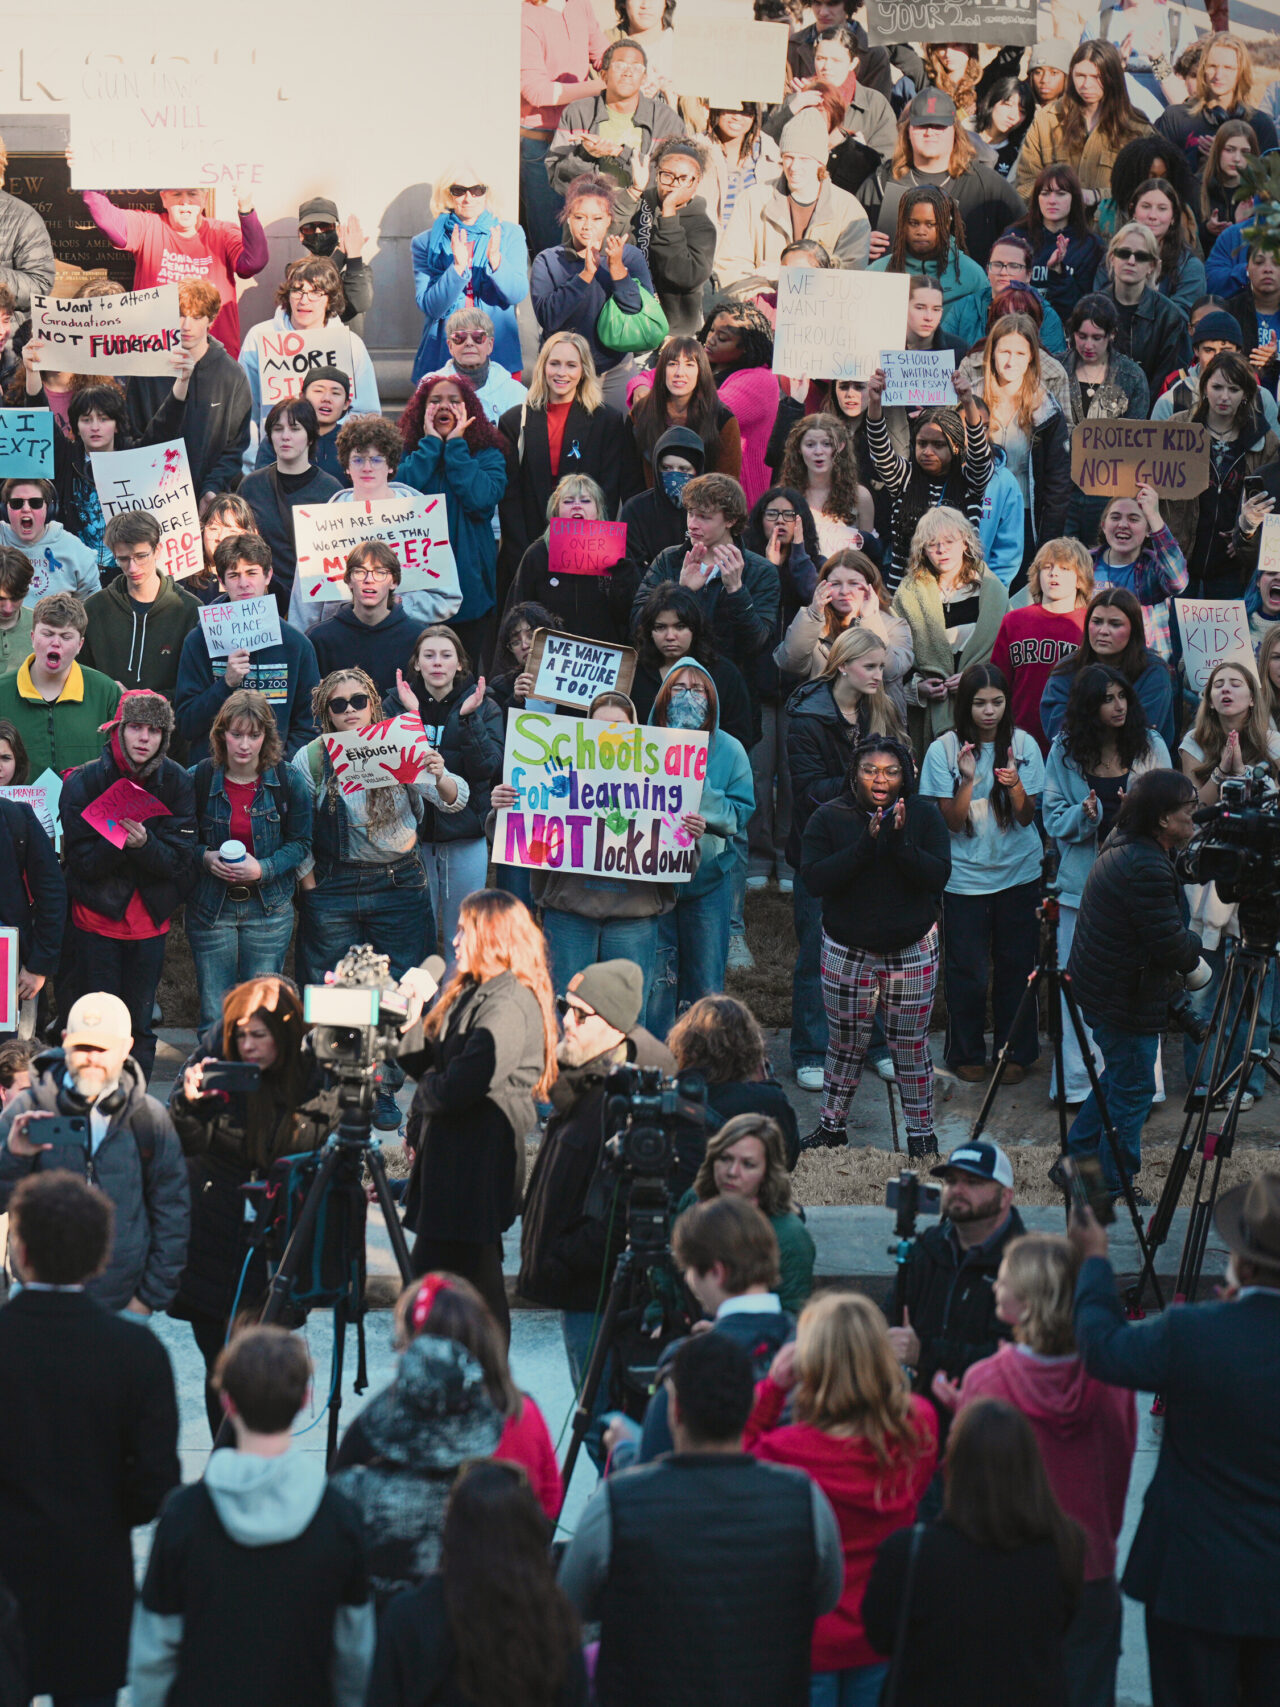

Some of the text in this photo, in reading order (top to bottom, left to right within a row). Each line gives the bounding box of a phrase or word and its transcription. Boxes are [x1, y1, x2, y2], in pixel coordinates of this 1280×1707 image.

[878, 3, 946, 34] YOUR
[140, 105, 208, 129] WILL
[200, 163, 265, 185] SAFE
[161, 258, 209, 275] DEMAND
[787, 274, 816, 296] WE
[34, 289, 160, 310] I to attend
[781, 300, 828, 318] WANT
[40, 312, 122, 328] Graduations
[38, 329, 83, 346] NOT
[262, 333, 304, 358] NO
[781, 323, 857, 350] THROUGH
[263, 350, 337, 373] MORE
[782, 349, 823, 373] HIGH
[882, 353, 939, 366] I SHOULD
[900, 368, 939, 379] WRITING
[886, 380, 947, 390] COLLEGE ESSAY
[908, 389, 925, 402] MY
[16, 414, 35, 431] I
[1082, 427, 1206, 453] PROTECT KIDS
[1080, 458, 1187, 488] NOT GUNS
[113, 480, 135, 498] I
[102, 484, 191, 517] THOUGHT
[315, 514, 375, 532] WHY ARE
[399, 527, 430, 539] THAN
[552, 520, 624, 537] CHILDREN
[569, 538, 606, 551] OVER
[202, 601, 267, 623] FEAR HAS
[1182, 604, 1240, 624] PROTECT
[209, 620, 261, 636] NO PLACE
[211, 632, 279, 650] IN SCHOOL
[1185, 627, 1246, 653] KIDS
[548, 640, 615, 666] WE WANT
[546, 659, 617, 685] A FUTURE
[268, 680, 288, 688] ZOO
[555, 677, 597, 700] TOO!
[512, 713, 707, 781] Schools are
[13, 787, 46, 798] PRAYERS
[511, 767, 683, 814] for learning
[505, 812, 592, 869] NOT
